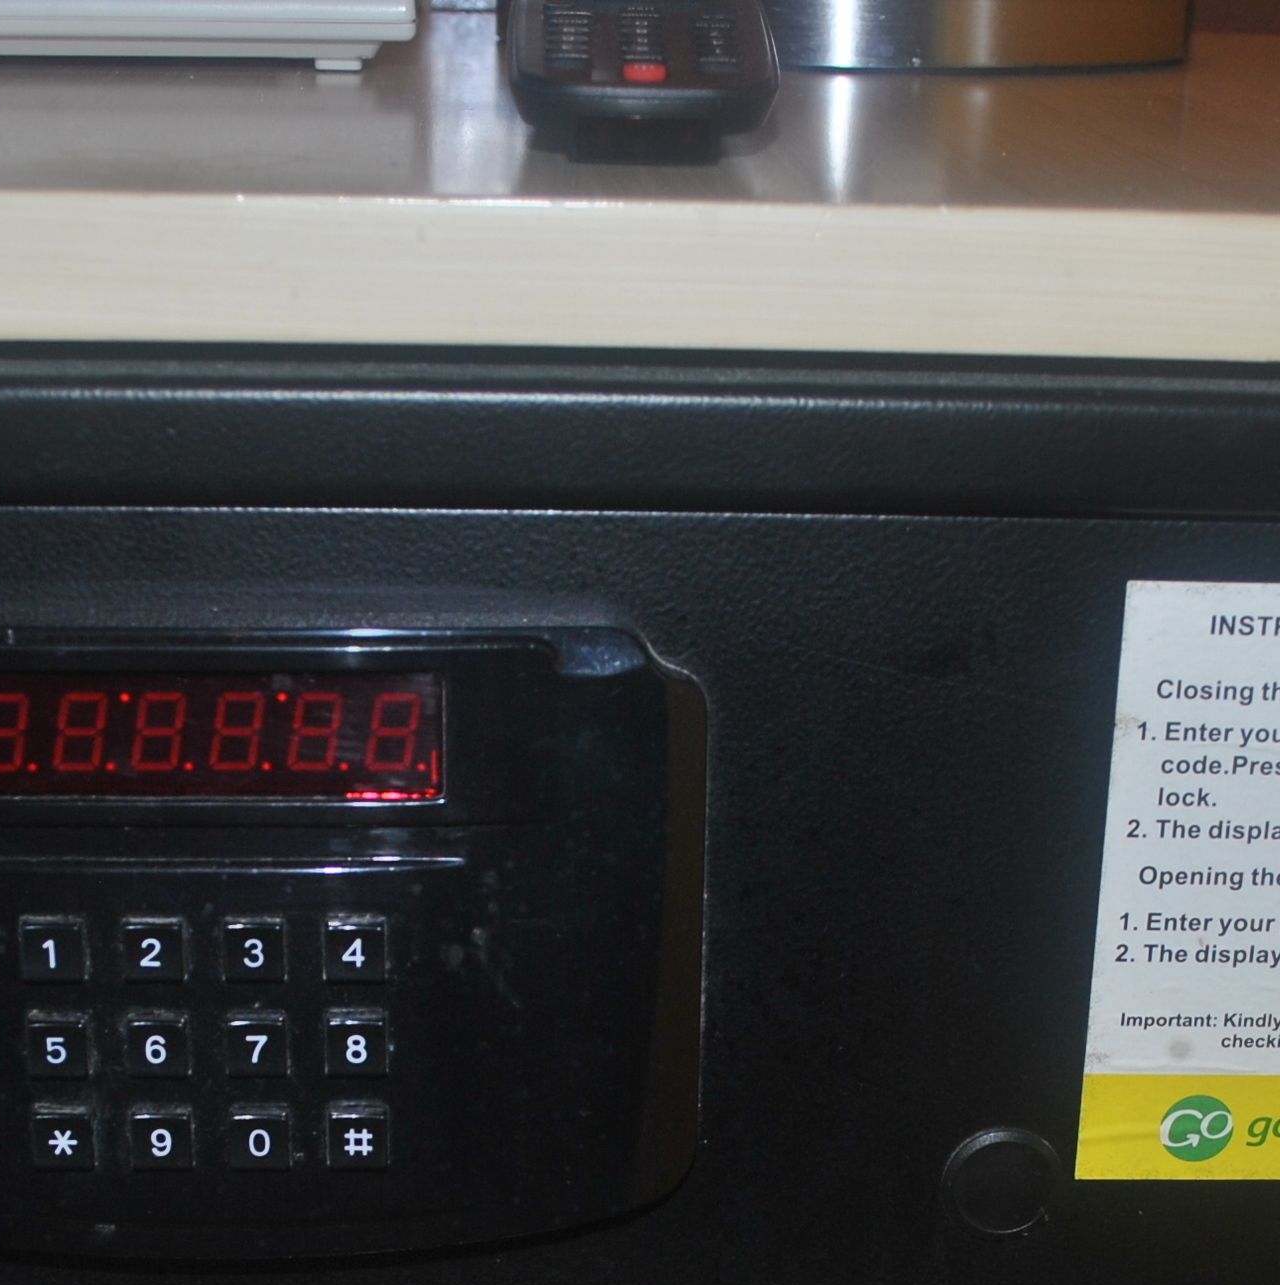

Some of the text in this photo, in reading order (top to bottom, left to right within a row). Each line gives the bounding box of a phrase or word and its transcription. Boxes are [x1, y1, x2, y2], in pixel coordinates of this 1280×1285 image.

[1156, 679, 1254, 706] Closing
[1137, 721, 1156, 741] 1.
[1164, 721, 1234, 743] Enter
[1157, 786, 1217, 807] lock.
[1126, 818, 1147, 839] 2.
[1155, 819, 1201, 839] The
[1138, 865, 1244, 891] Opening
[1119, 911, 1138, 932] 1.
[1146, 912, 1214, 932] Enter
[1217, 917, 1276, 937] your
[41, 937, 366, 969] 1 2 3 4
[1114, 943, 1135, 963] 2.
[1143, 943, 1188, 963] The
[1120, 1012, 1218, 1031] Important:
[46, 1034, 368, 1065] 5 6 7 8
[150, 1128, 172, 1157] 9
[248, 1128, 271, 1157] 0
[343, 1128, 373, 1156] #
